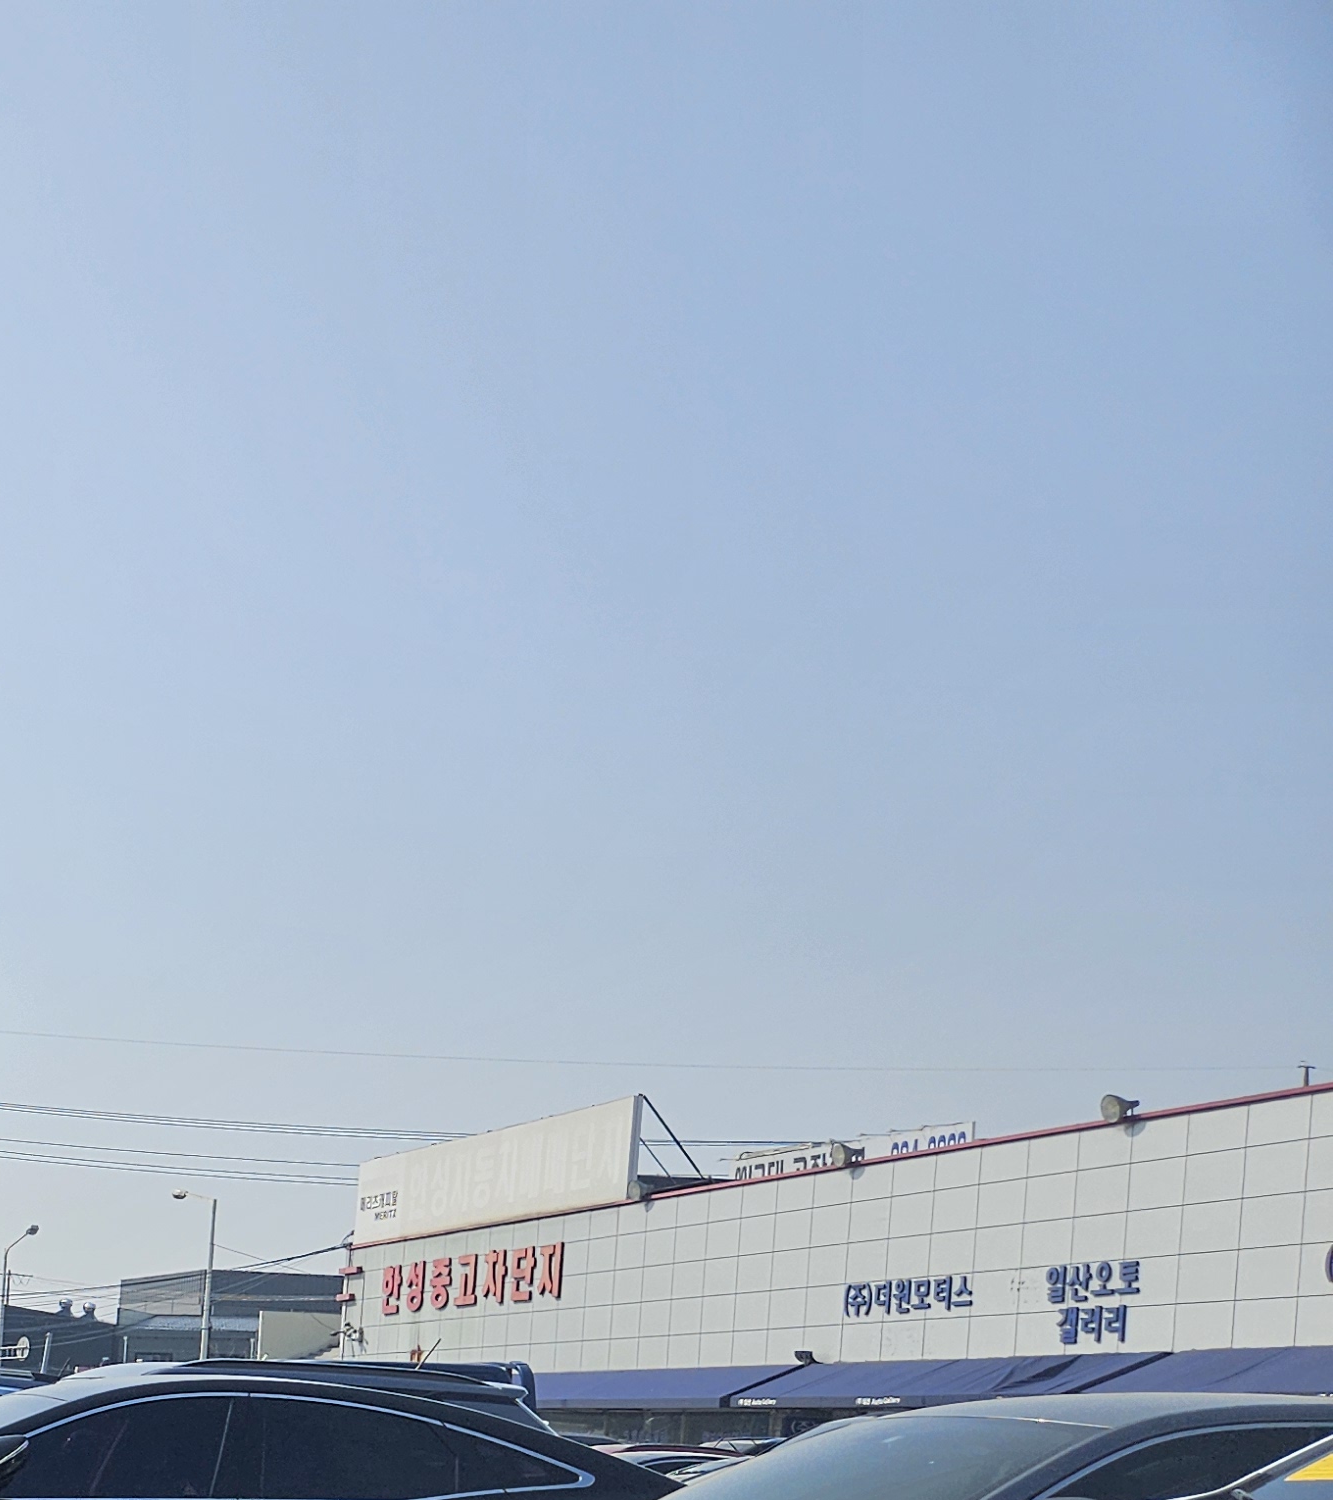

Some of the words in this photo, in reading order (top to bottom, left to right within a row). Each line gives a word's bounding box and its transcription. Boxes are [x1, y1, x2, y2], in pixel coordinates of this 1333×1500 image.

[382, 1242, 565, 1316] 한성중고차단지
[1045, 1260, 1140, 1305] 일산오토
[1055, 1304, 1127, 1345] 갤러리
